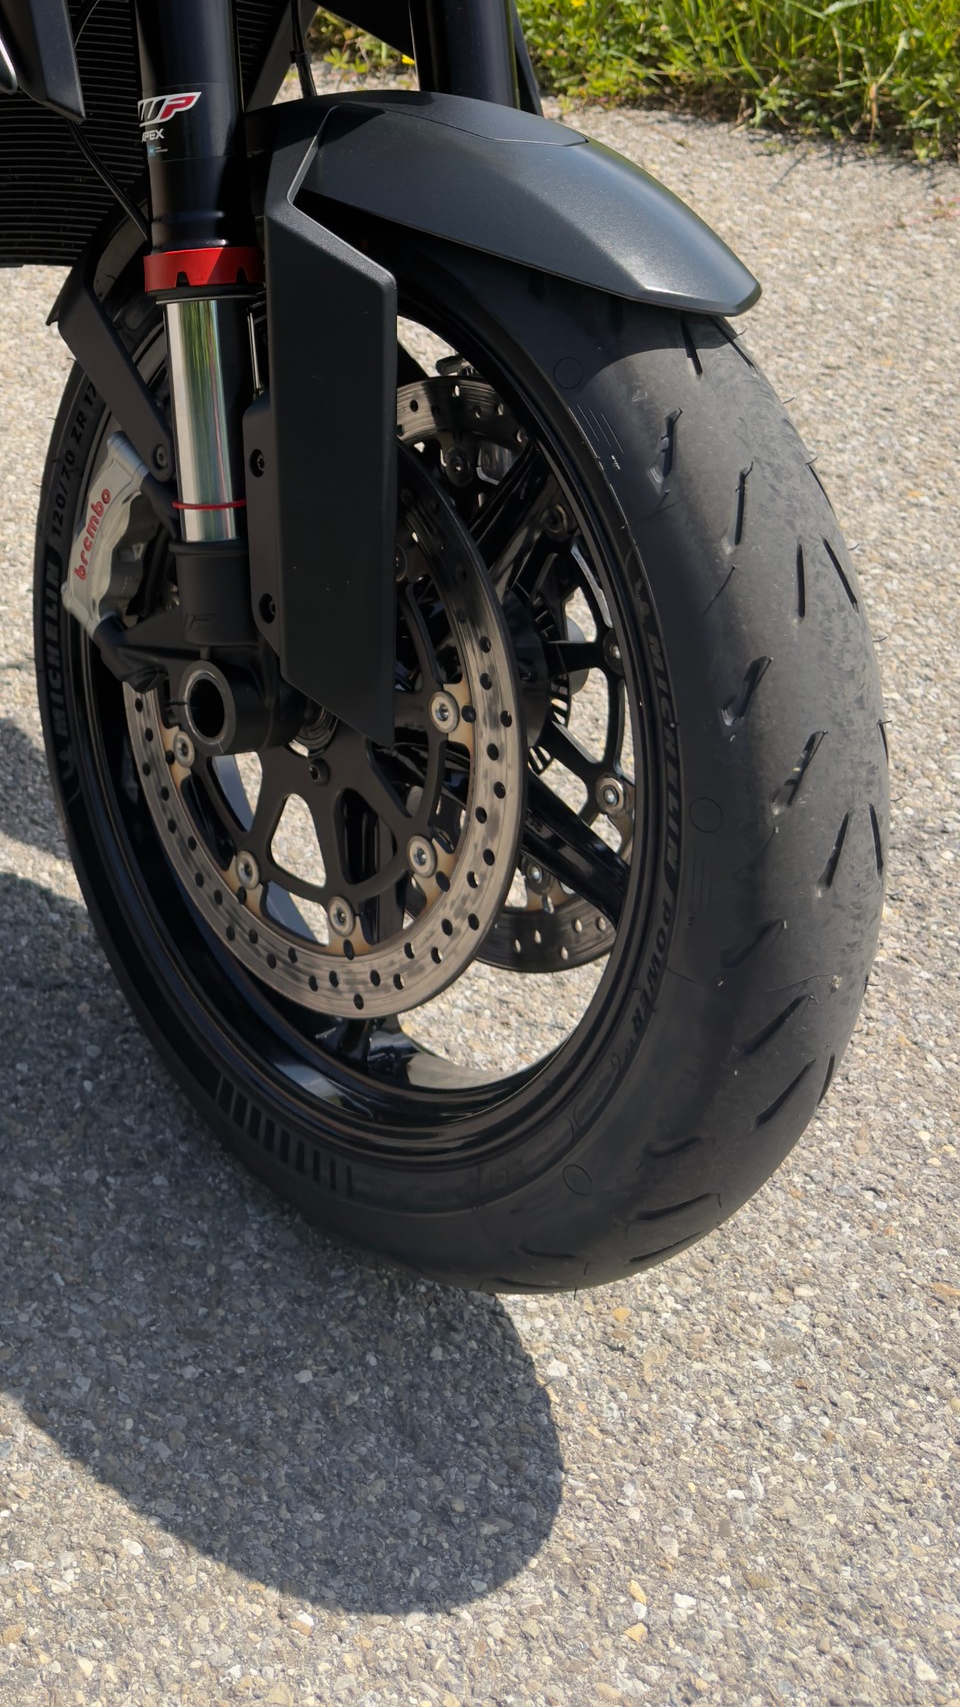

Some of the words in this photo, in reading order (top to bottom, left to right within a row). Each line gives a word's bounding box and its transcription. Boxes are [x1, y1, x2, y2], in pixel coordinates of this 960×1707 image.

[75, 488, 111, 580] brembo
[44, 560, 69, 737] MICHELIN
[647, 632, 679, 871] MICHELIN
[632, 897, 671, 1034] POWER
